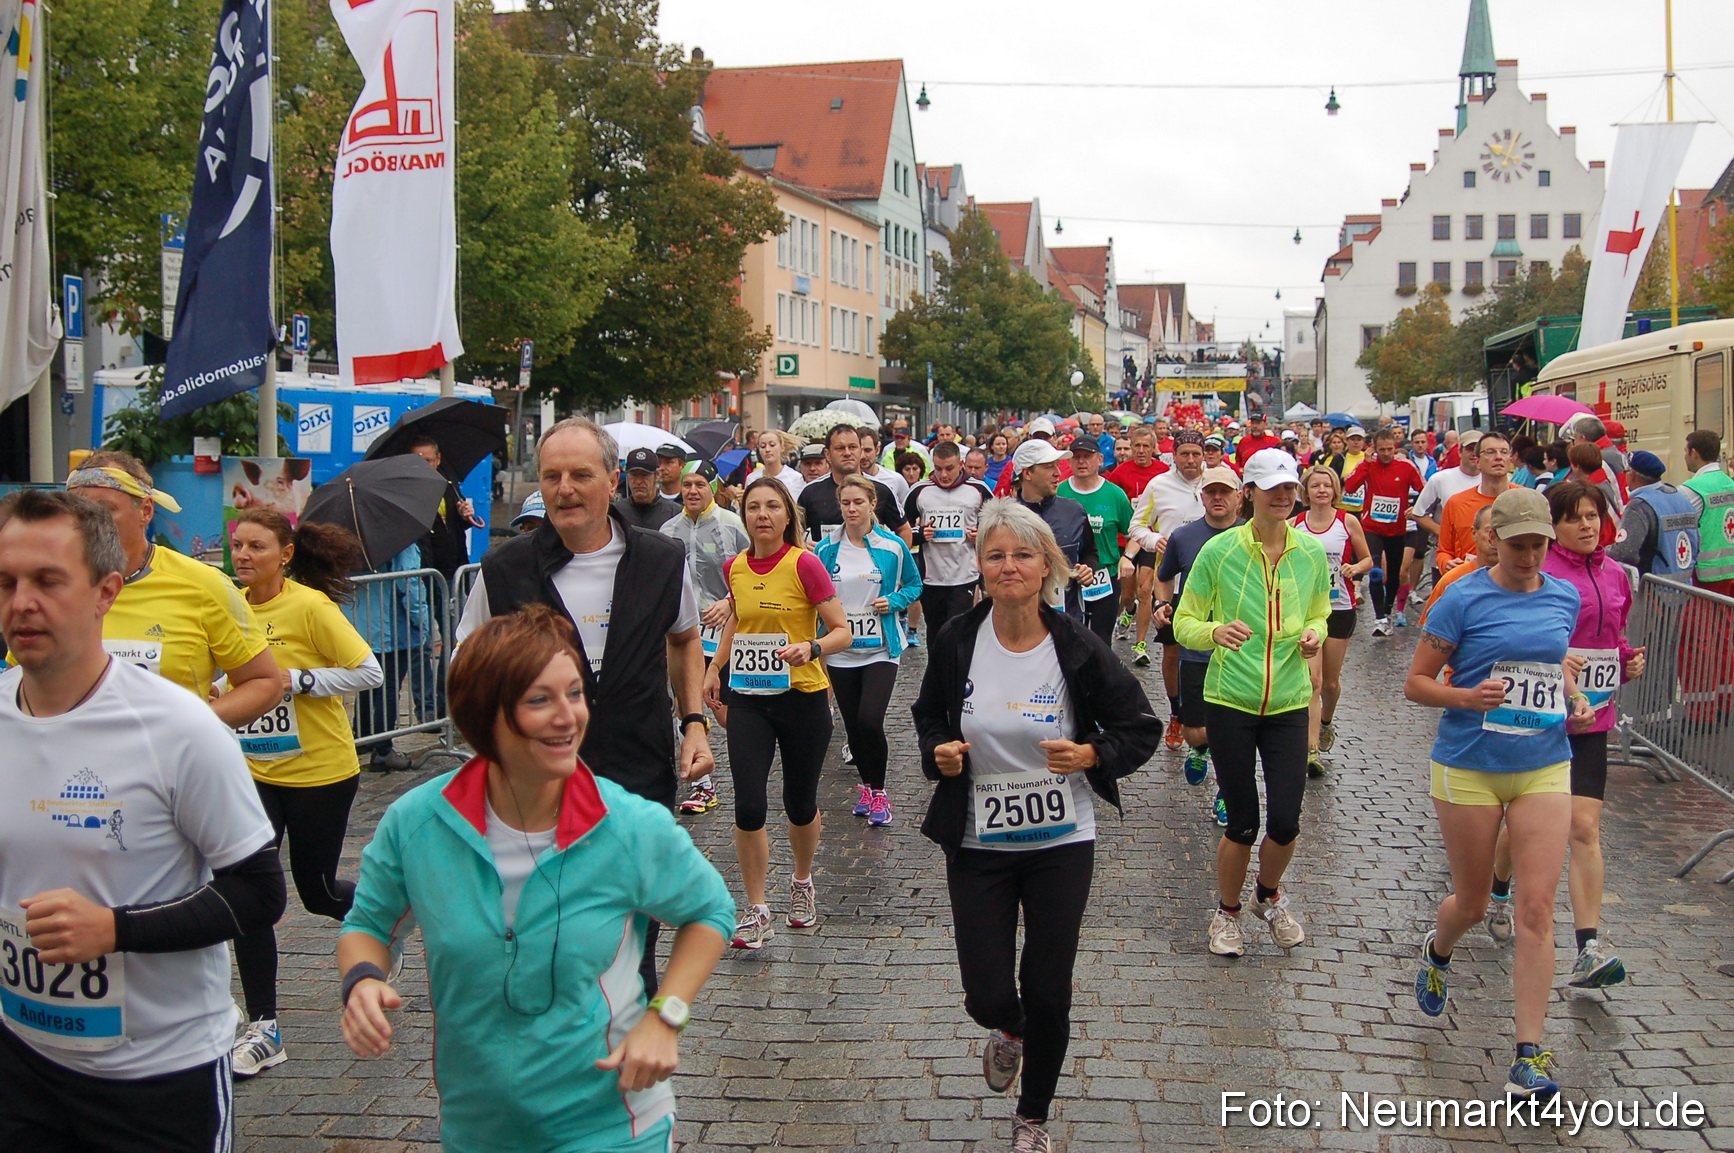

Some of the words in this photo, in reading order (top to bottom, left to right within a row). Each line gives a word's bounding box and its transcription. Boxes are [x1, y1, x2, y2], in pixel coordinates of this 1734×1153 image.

[67, 284, 79, 330] P
[296, 319, 306, 346] P
[1185, 381, 1216, 389] START
[1616, 371, 1668, 399] Bayerisches
[1615, 401, 1640, 421] Rotes
[1374, 502, 1398, 514] 2202
[929, 514, 961, 529] 2712
[734, 648, 784, 672] 2358
[744, 677, 772, 687] Sabine
[1502, 676, 1558, 709] 2161
[1513, 712, 1541, 727] Katja
[245, 740, 280, 751] Kerstin
[1007, 778, 1053, 791] Neumarkt
[984, 789, 1066, 829] 2509
[1005, 831, 1051, 842] Kerstin
[2, 939, 109, 1000] 3028
[20, 1002, 86, 1032] Andreas
